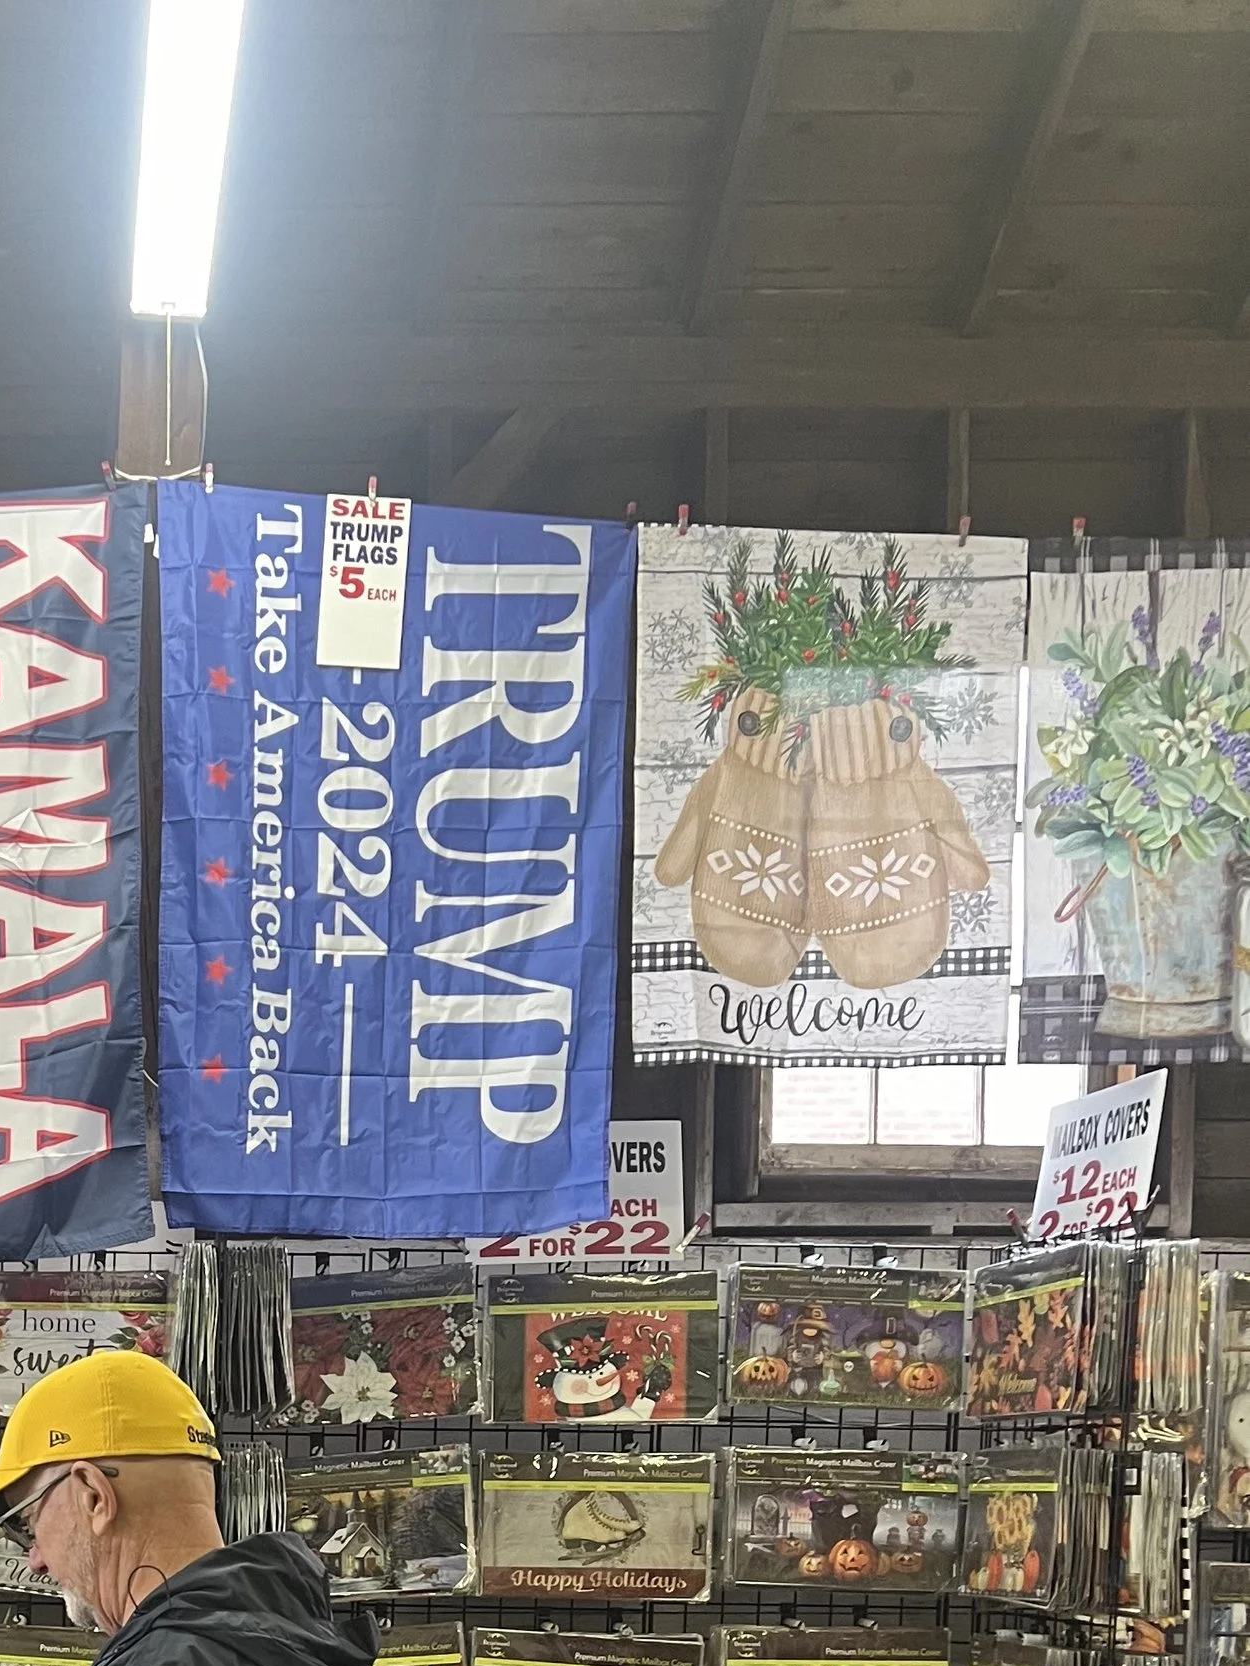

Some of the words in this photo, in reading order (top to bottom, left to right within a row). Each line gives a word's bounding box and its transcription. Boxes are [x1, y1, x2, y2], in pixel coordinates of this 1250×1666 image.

[332, 499, 405, 520] SALE
[330, 521, 403, 543] TRUMP
[332, 543, 398, 565] FLAGS
[253, 503, 303, 674] Take
[330, 565, 365, 599] $5
[367, 588, 397, 602] EACH
[251, 690, 299, 975] America
[314, 697, 396, 967] 2024
[409, 524, 593, 1144] TRUMP
[708, 982, 926, 1046] Welcome
[245, 991, 293, 1154] Back
[1050, 1113, 1102, 1159] MAILBOX
[1104, 1099, 1151, 1145] COVERS
[609, 1141, 666, 1173] VERS
[1053, 1160, 1102, 1205] $12
[1102, 1166, 1137, 1194] EACH
[610, 1199, 657, 1217] ACH
[529, 1238, 575, 1256] FOR
[569, 1220, 670, 1254] $22
[22, 1309, 96, 1334] home
[351, 1459, 381, 1469] Mailbox
[382, 1457, 406, 1467] Cover
[806, 1458, 841, 1468] Magnetic
[843, 1459, 872, 1468] Mailbox
[874, 1460, 897, 1468] Cover
[511, 1570, 588, 1592] Happy
[589, 1570, 687, 1592] Holidays
[574, 1651, 606, 1662] Premium
